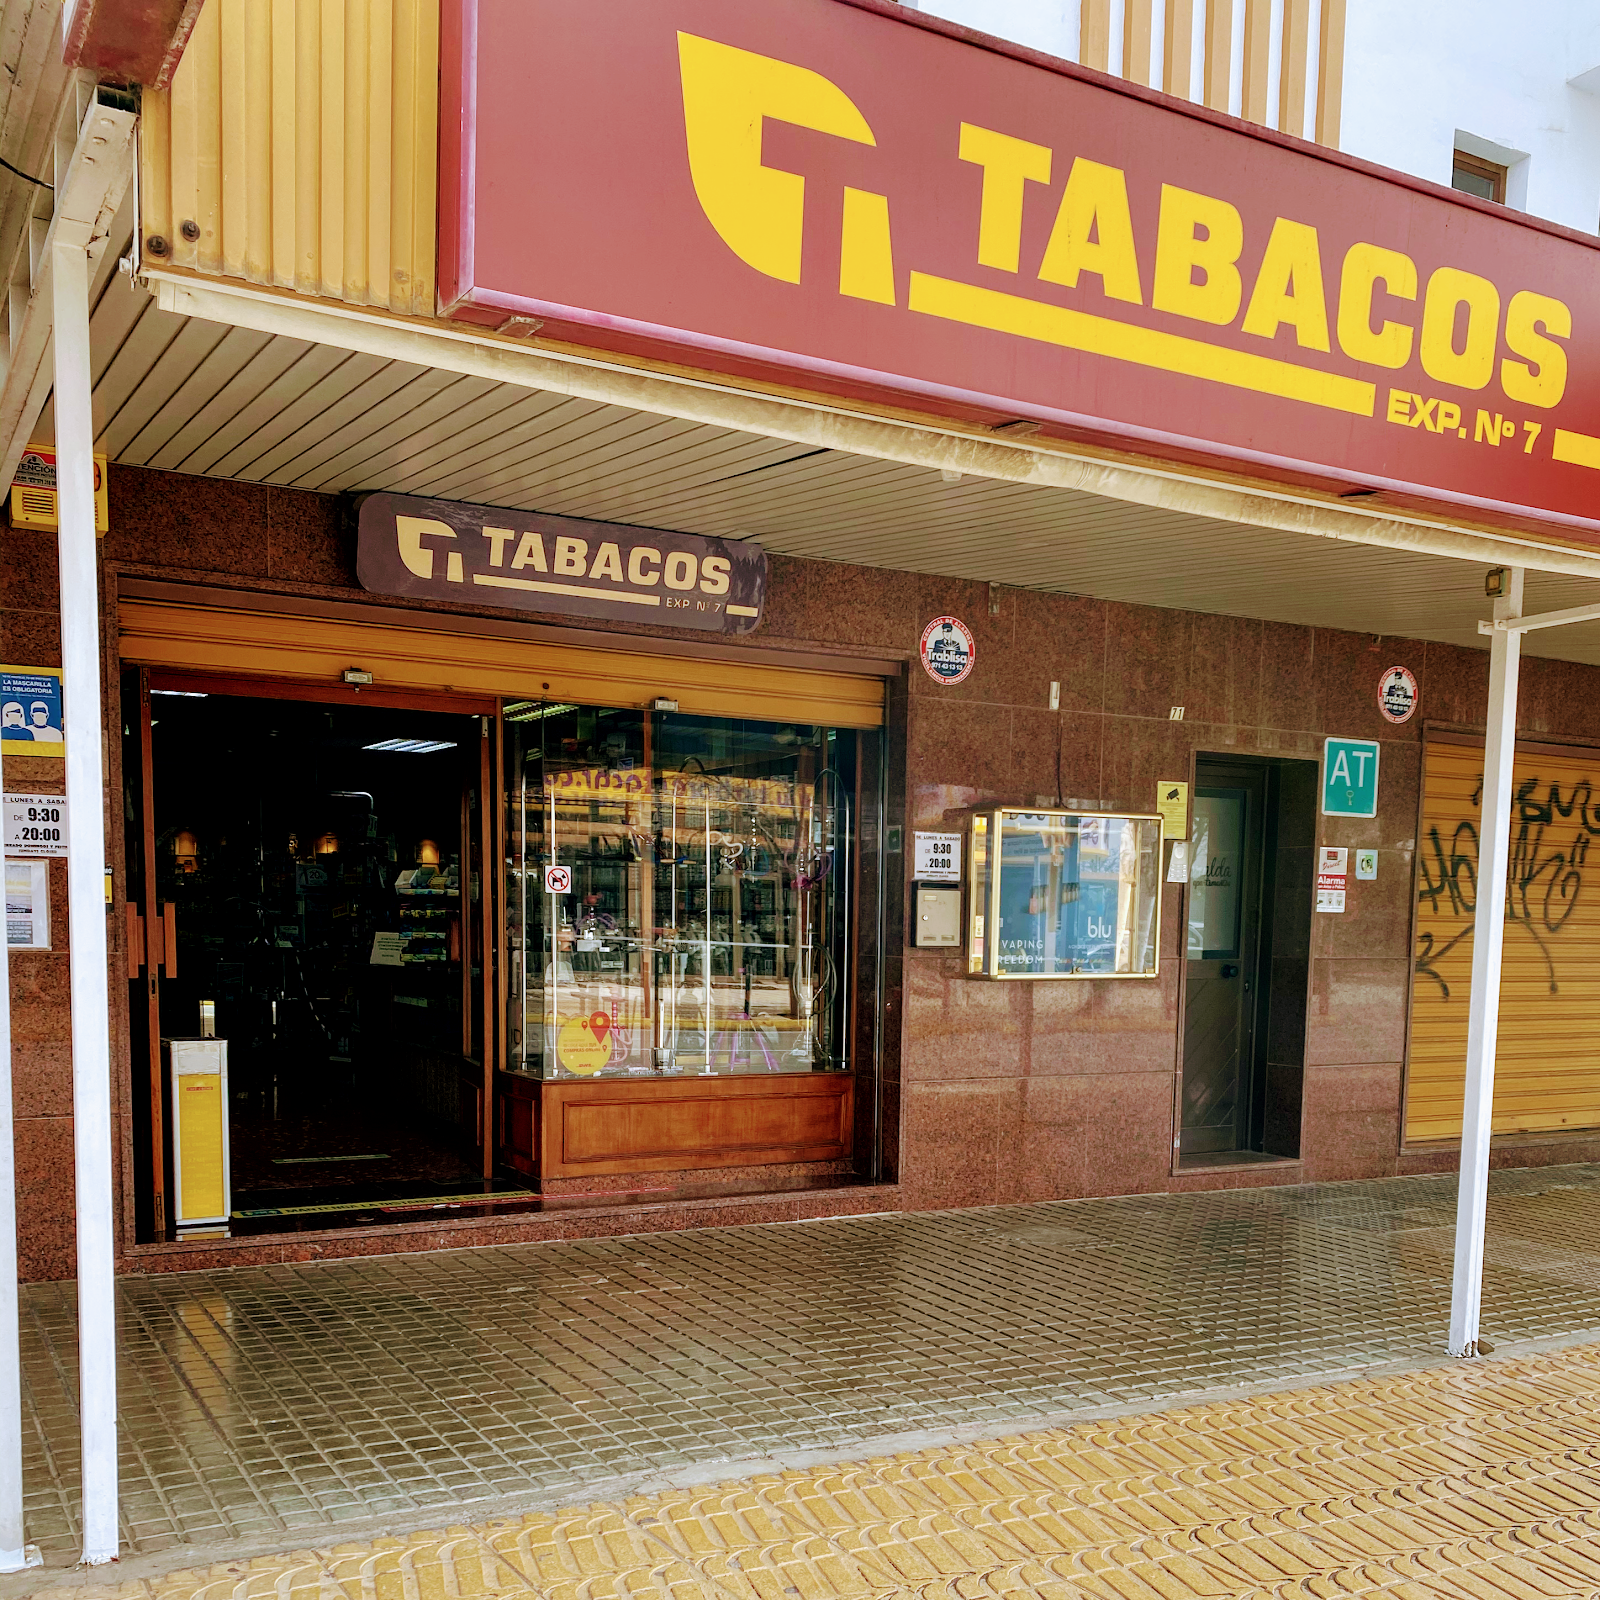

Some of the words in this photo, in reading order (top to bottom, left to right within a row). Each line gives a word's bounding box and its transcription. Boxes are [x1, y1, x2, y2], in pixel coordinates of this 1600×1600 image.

[958, 121, 1572, 409] TABACOS
[1386, 387, 1467, 439] EXP.
[1523, 420, 1543, 455] 7
[18, 463, 57, 474] TENCIÓN
[481, 526, 731, 595] TABACOS
[714, 603, 721, 613] 7
[927, 648, 968, 664] Trablisa
[12, 680, 52, 688] MASCARILLA
[12, 686, 53, 694] OBLIGATORIA
[1383, 692, 1412, 706] Trablisa
[1172, 707, 1182, 719] 71
[1329, 749, 1374, 788] AT
[28, 807, 60, 823] 9:30
[22, 827, 60, 841] 20:00
[933, 843, 951, 854] 9:30
[929, 858, 951, 868] 20:00
[1317, 876, 1345, 885] Alarma
[1087, 916, 1112, 938] blu
[1001, 939, 1044, 949] VAPING
[998, 954, 1043, 965] REEDOM
